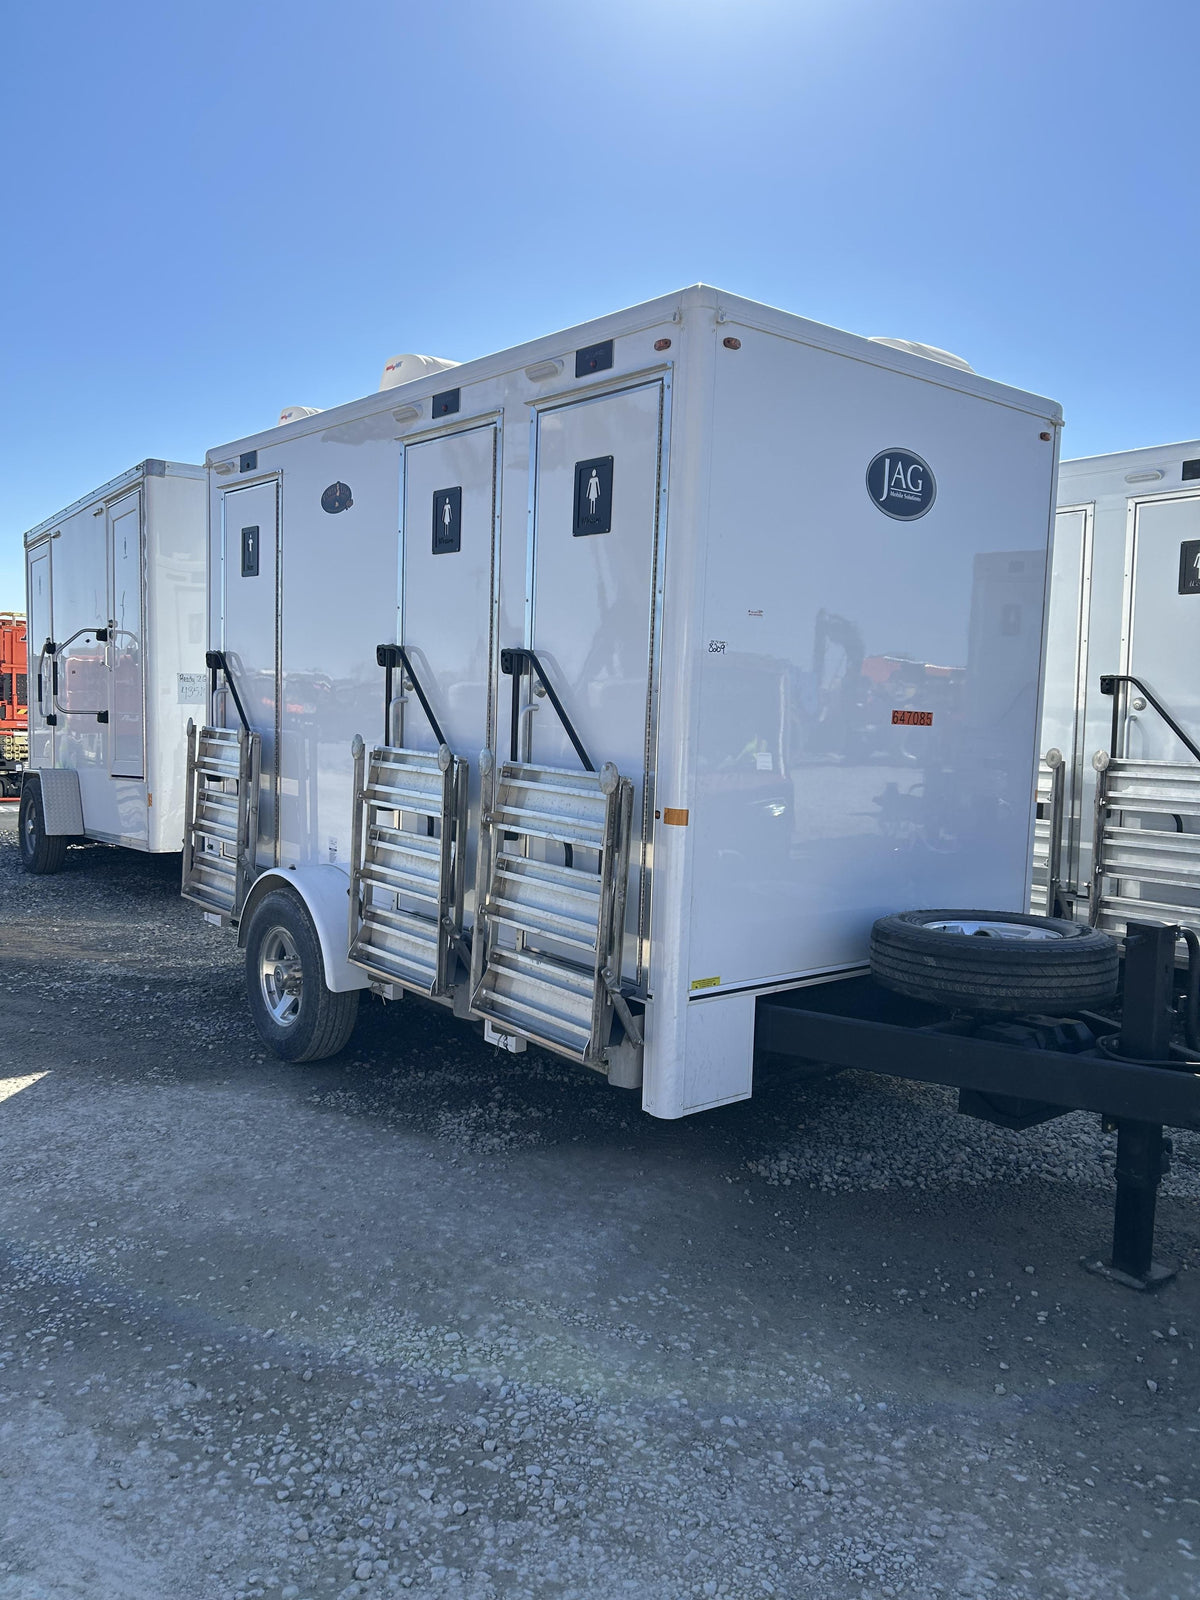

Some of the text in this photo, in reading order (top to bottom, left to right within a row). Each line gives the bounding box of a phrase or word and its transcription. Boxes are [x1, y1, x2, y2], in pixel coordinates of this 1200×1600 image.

[880, 458, 923, 502] JAG
[890, 490, 921, 502] Mobile Solutions
[892, 710, 932, 726] 647085
